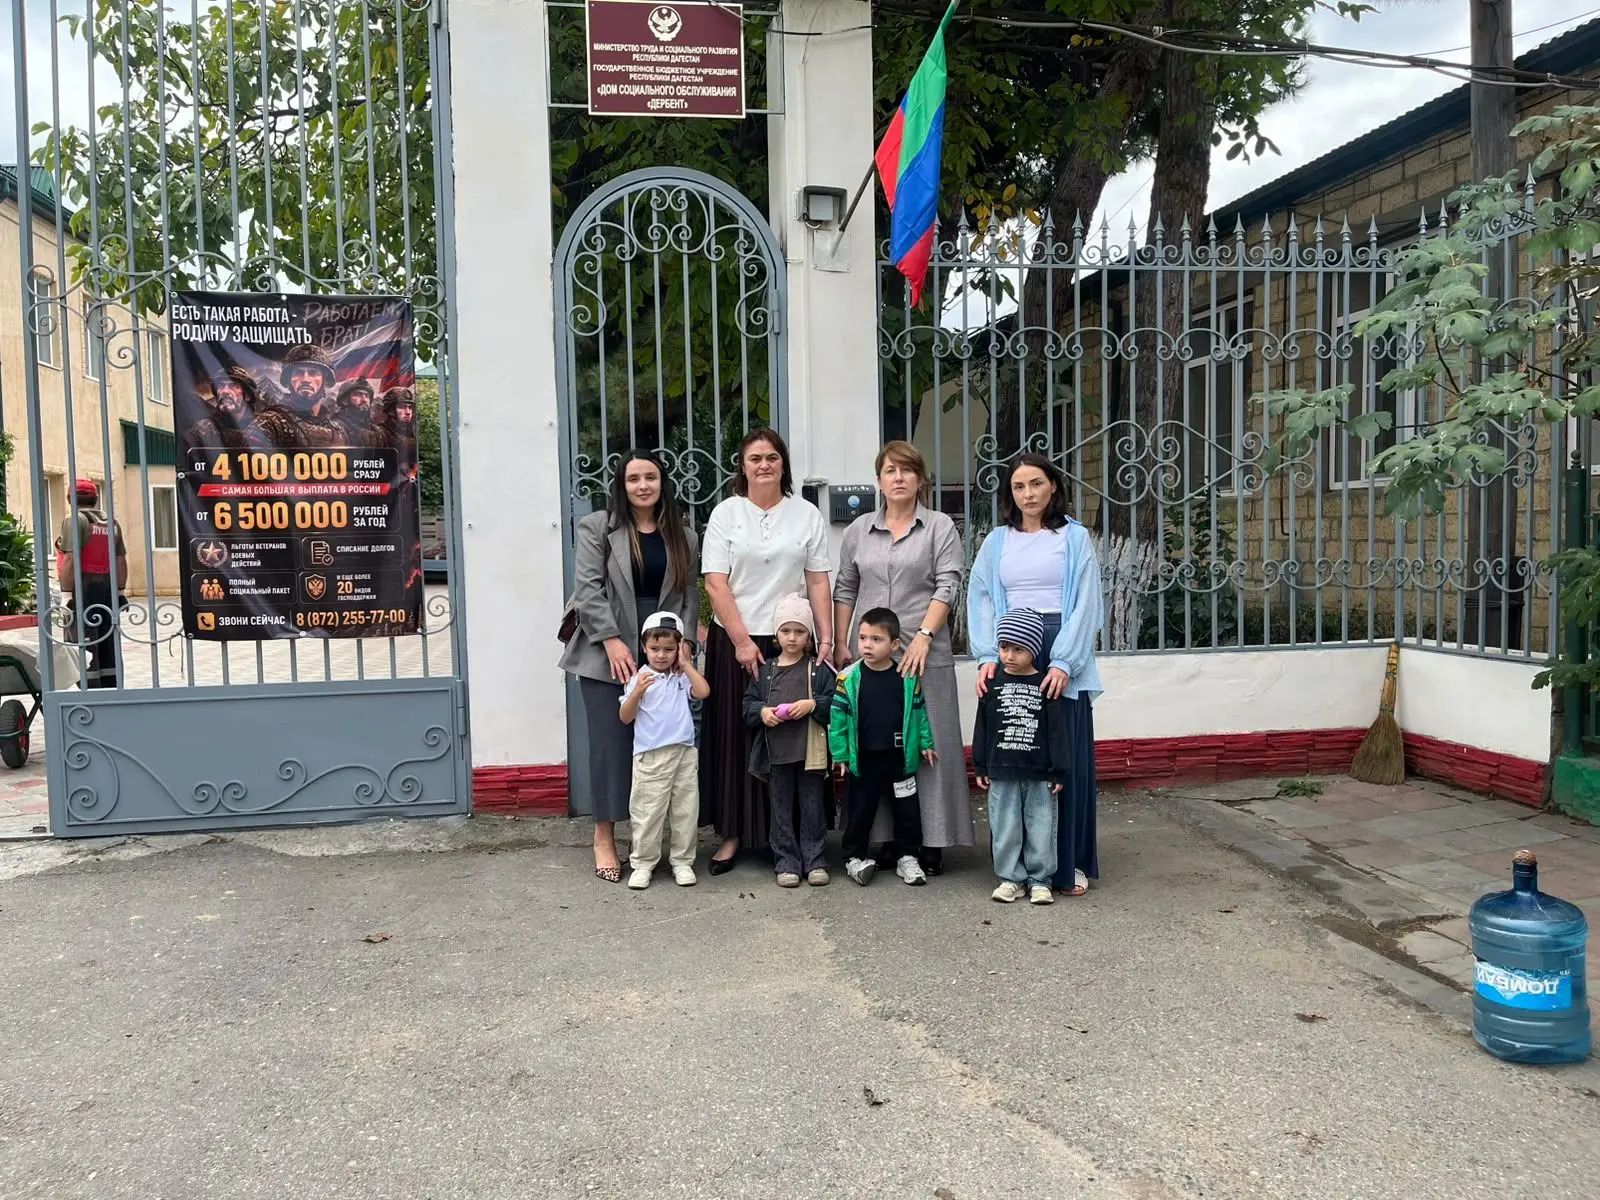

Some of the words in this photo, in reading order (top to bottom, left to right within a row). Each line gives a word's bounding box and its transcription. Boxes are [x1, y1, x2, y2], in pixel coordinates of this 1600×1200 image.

[594, 43, 639, 52] МИНИСТЕРСТВО
[664, 46, 707, 54] СОЦИАЛЬНОГО
[593, 64, 655, 73] ГОСУДАРСТВЕННОЕ
[656, 67, 696, 75] БЮДЖЕТНОЕ
[697, 68, 738, 76] УЧРЕЖДЕНИЕ
[630, 74, 670, 82] РЕСПУБЛИКИ
[597, 85, 617, 95] «ДОМ
[618, 85, 675, 96] СОЦИАЛЬНОГО
[676, 86, 736, 97] ОБСЛУЖИВАНИЯ
[647, 99, 688, 109] «ДЕРБЕНТ»
[172, 305, 200, 320] ЕСТЬ
[203, 306, 241, 322] ТАКАЯ
[244, 307, 289, 323] РАБОТА
[172, 324, 229, 343] РОДИНУ
[233, 325, 312, 345] ЗАЩИЩАТЬ
[195, 462, 206, 471] ОТ
[212, 454, 231, 480] 4
[238, 453, 288, 480] 100
[294, 452, 347, 480] 000
[354, 459, 384, 469] РУБЛЕЙ
[354, 470, 380, 479] СРАЗУ
[222, 486, 252, 495] САМАЯ
[254, 486, 295, 495] БОЛЬШАЯ
[298, 486, 338, 494] ВЫПЛАТА
[341, 486, 346, 494] В
[348, 485, 380, 494] РОССИИ
[353, 504, 388, 515] РУБЛЕЙ
[197, 512, 208, 521] ОТ
[214, 502, 232, 530] 6
[238, 502, 289, 529] 500
[295, 501, 347, 529] 000
[354, 518, 366, 527] ЗА
[368, 517, 386, 528] ГОД
[336, 545, 369, 553] СПИСАНИЕ
[229, 578, 256, 586] ПОЛНЫЙ
[337, 581, 353, 594] 20
[229, 586, 271, 595] СОЦИАЛЬНЫЙ
[219, 617, 248, 626] ЗВОНИ
[251, 615, 286, 626] СЕЙЧАС
[296, 613, 304, 626] 8
[307, 611, 339, 627] (872)
[343, 609, 406, 625] 255-77-00
